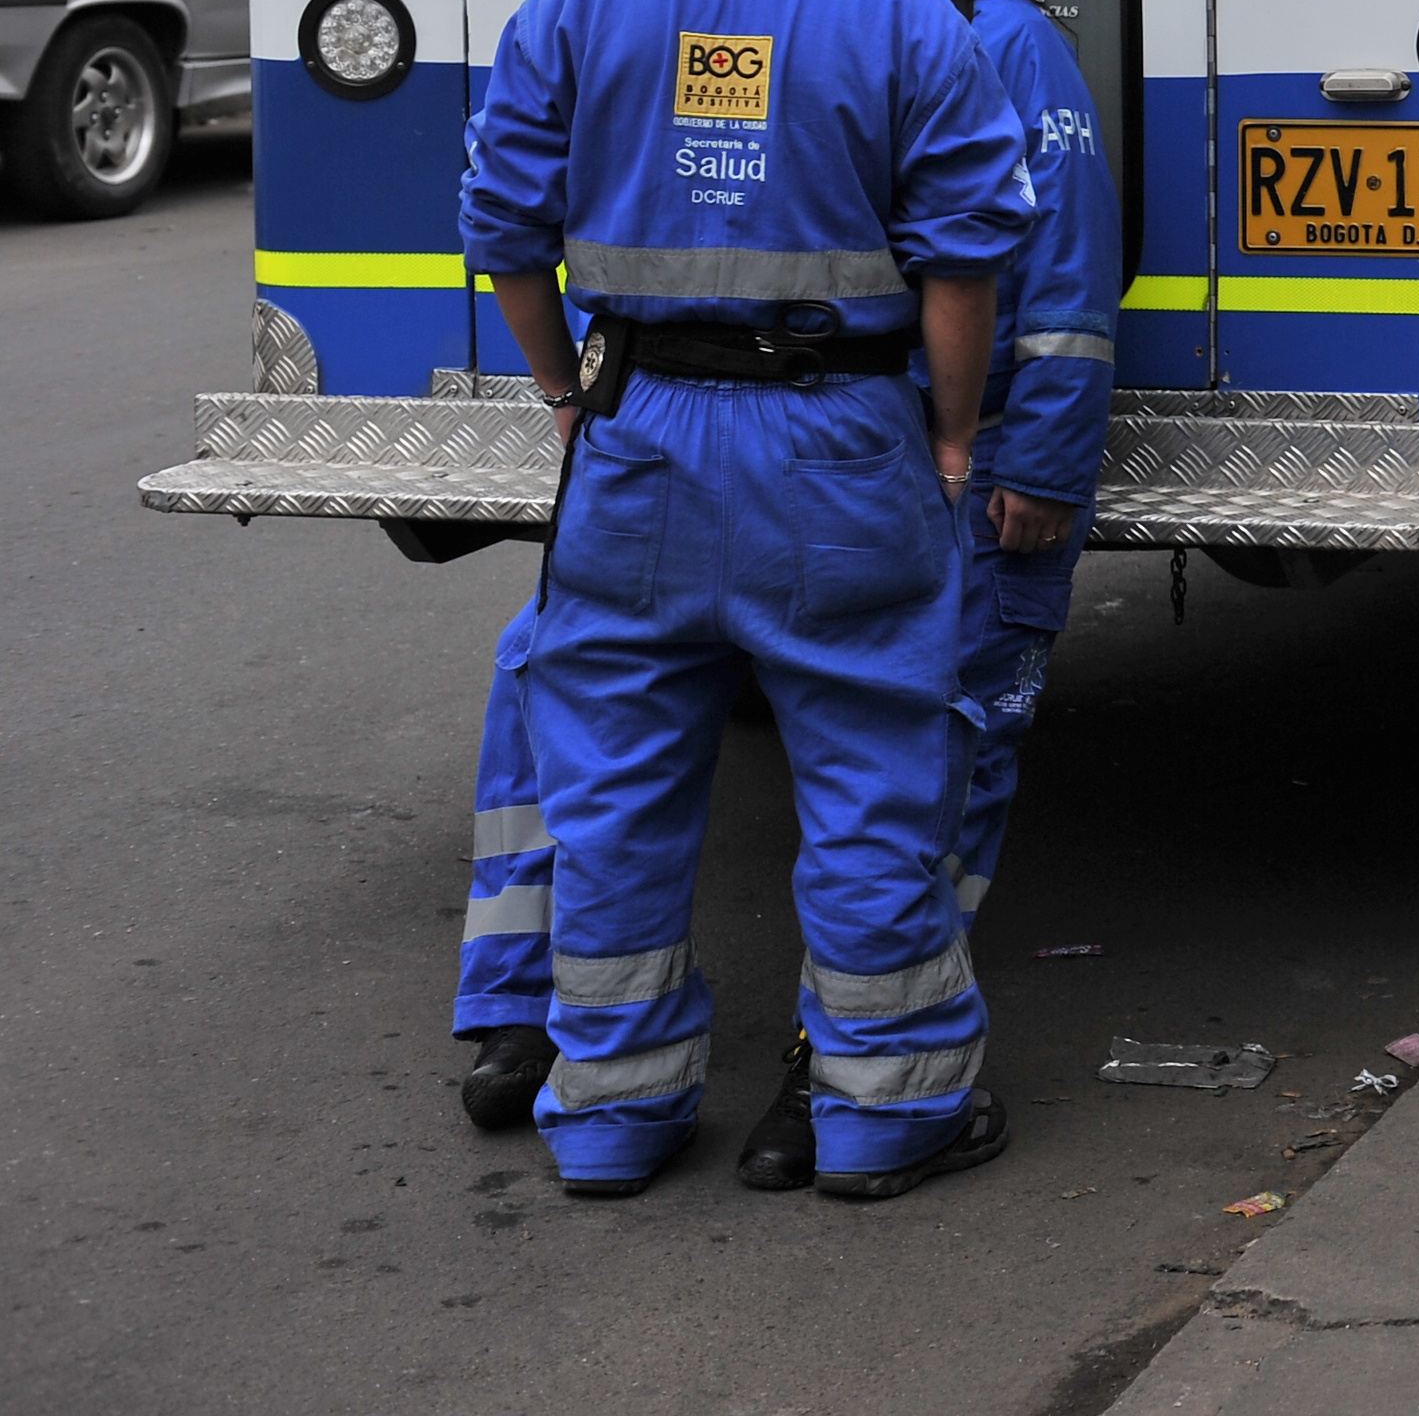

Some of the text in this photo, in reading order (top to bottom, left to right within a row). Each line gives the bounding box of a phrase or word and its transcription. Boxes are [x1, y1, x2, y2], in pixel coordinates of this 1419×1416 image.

[688, 44, 763, 79] BOG
[747, 140, 760, 150] de
[1040, 108, 1096, 156] APH
[675, 148, 767, 182] Salud
[691, 189, 745, 206] DCRUE
[1305, 222, 1387, 246] BOGOTA
